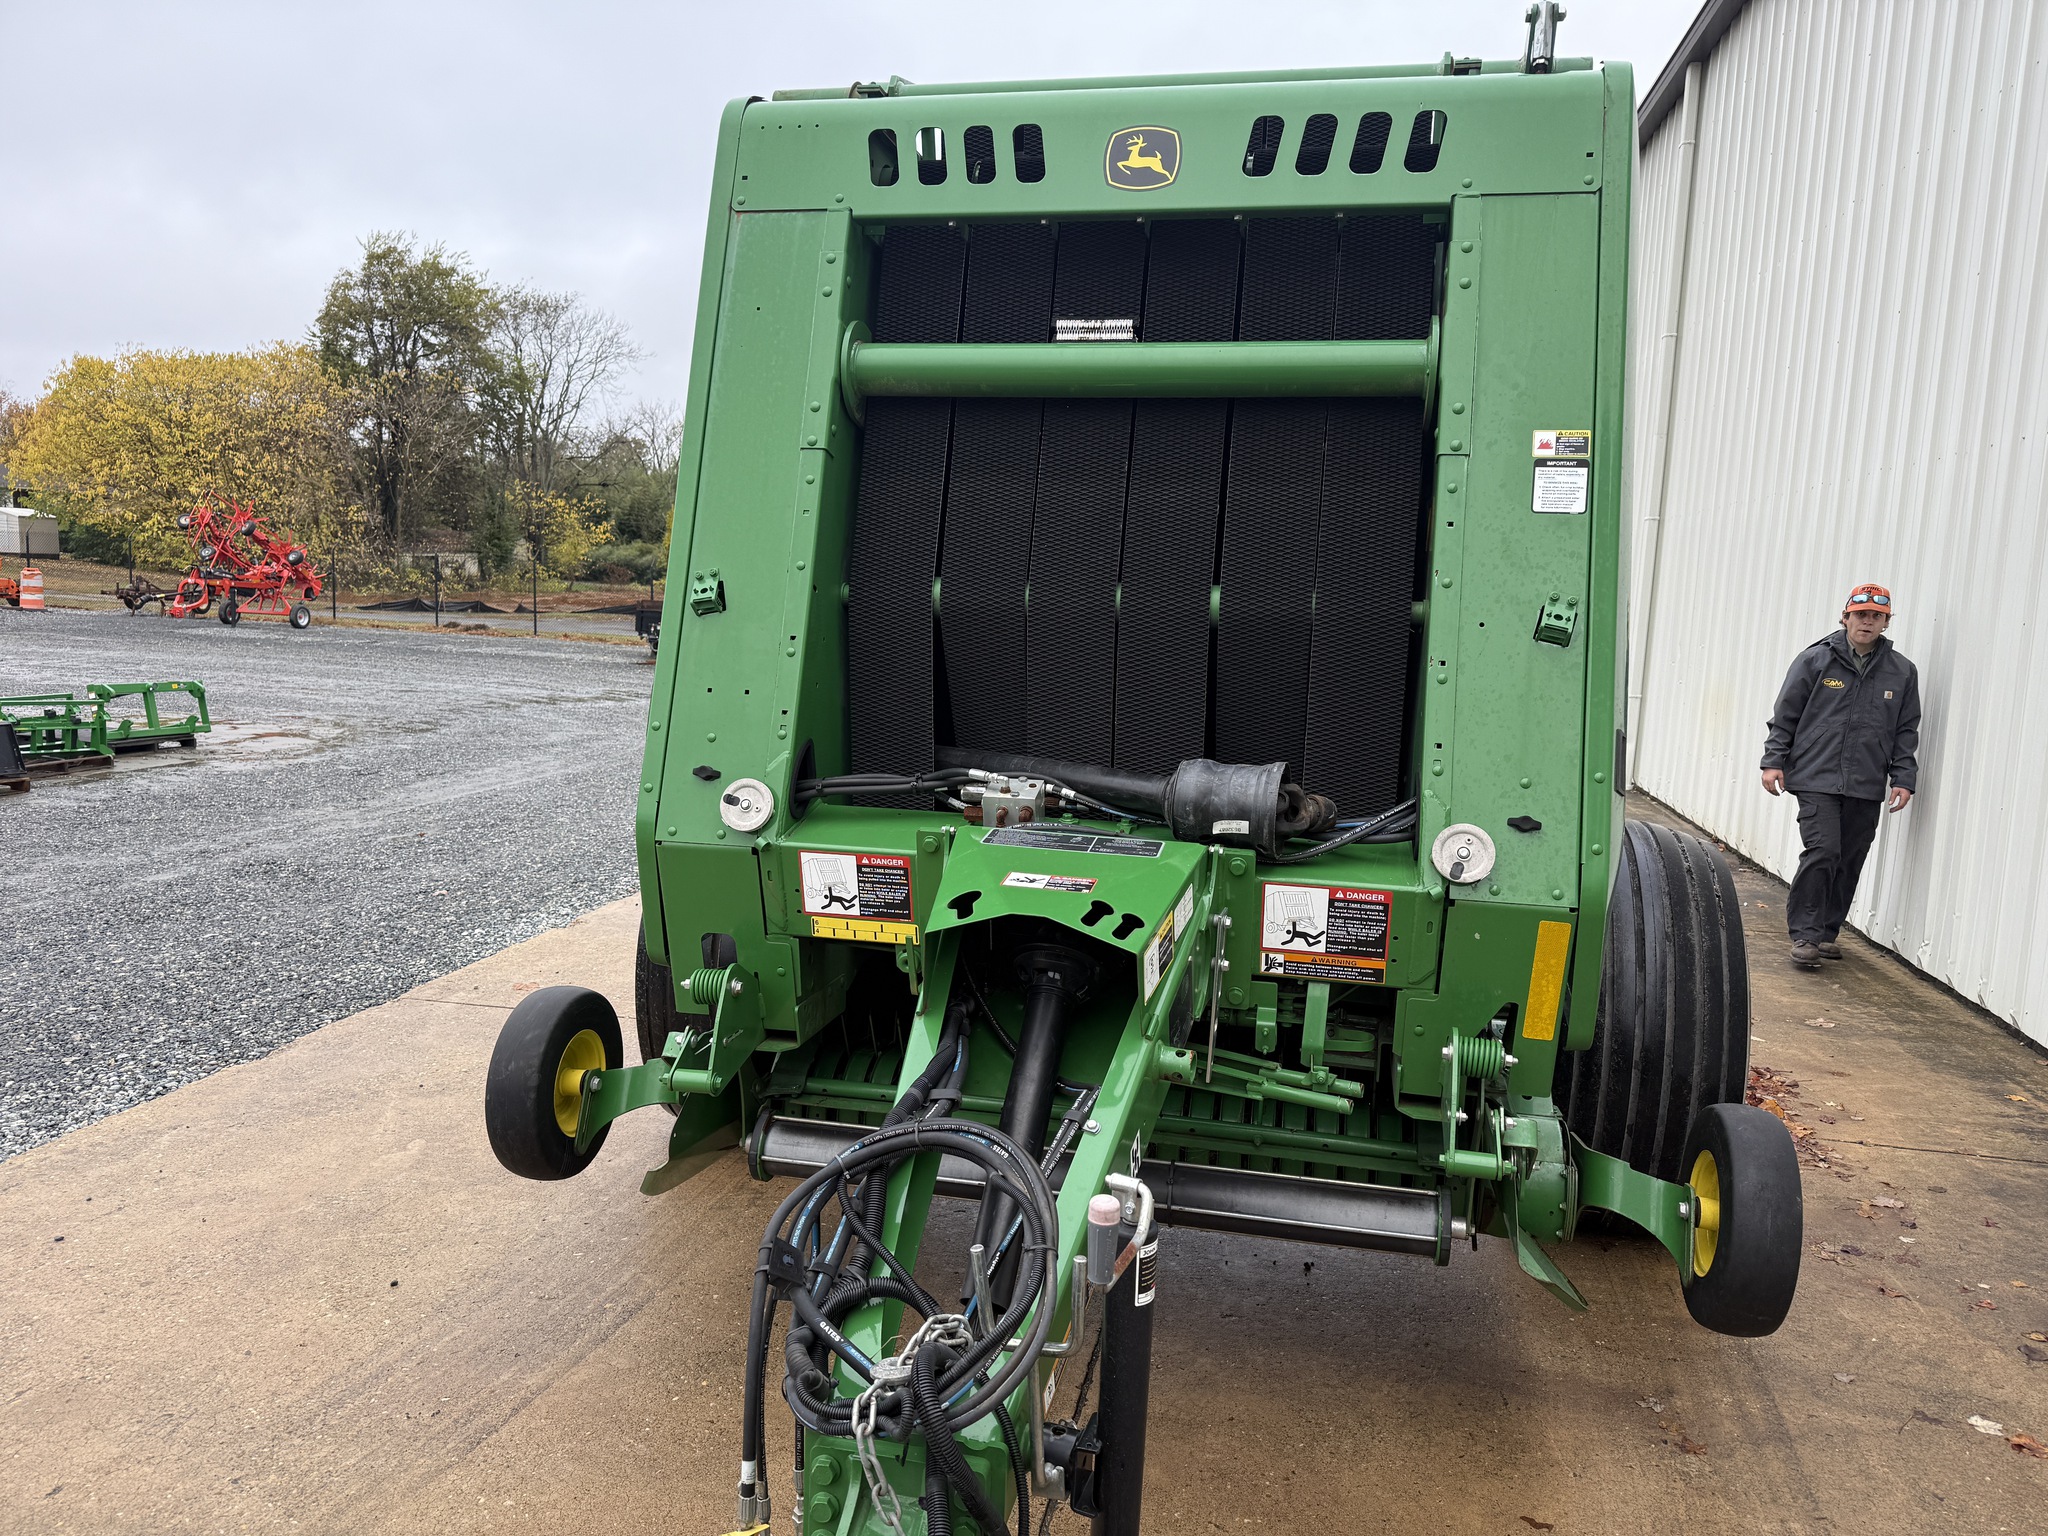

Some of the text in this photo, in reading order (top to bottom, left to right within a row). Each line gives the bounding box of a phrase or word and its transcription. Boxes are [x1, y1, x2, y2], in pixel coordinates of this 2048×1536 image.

[871, 858, 904, 866] DANGER
[1346, 892, 1384, 901] DANGER
[1318, 957, 1357, 966] WARNING
